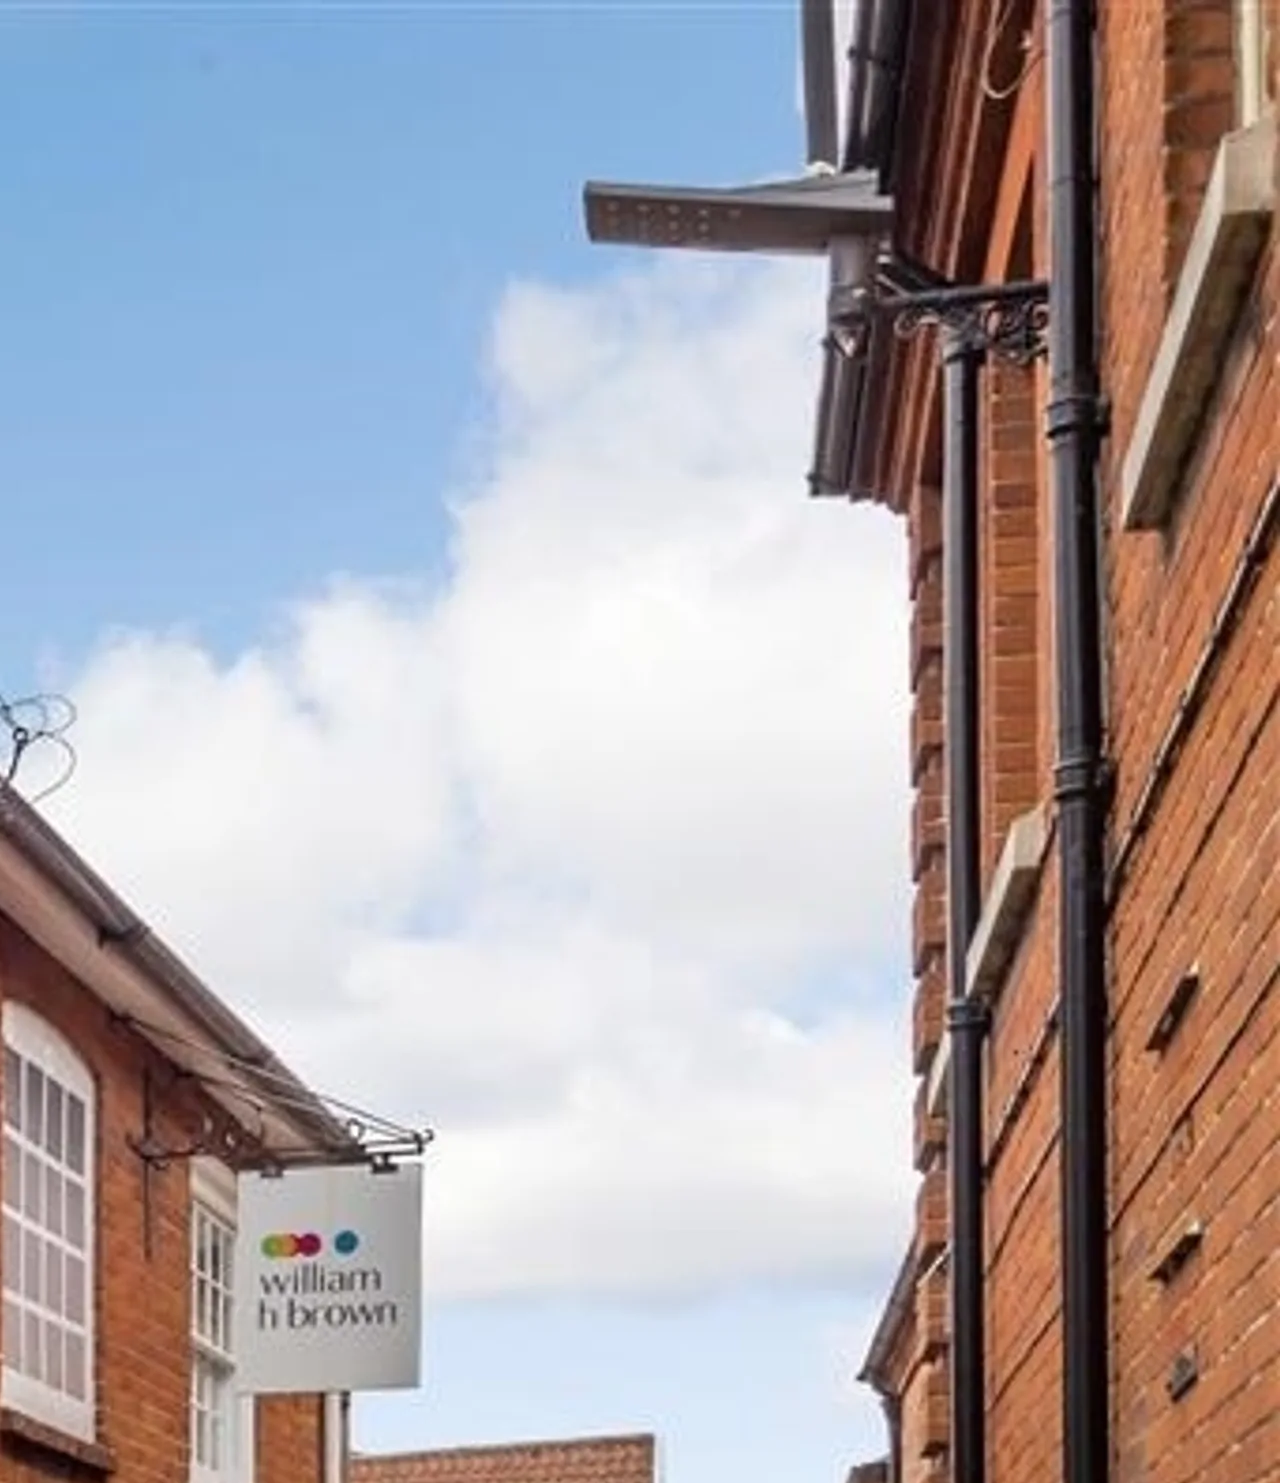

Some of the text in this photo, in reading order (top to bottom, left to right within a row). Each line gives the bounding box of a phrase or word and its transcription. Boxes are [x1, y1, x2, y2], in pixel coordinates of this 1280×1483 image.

[258, 1262, 382, 1295] william
[259, 1298, 397, 1329] h brown
